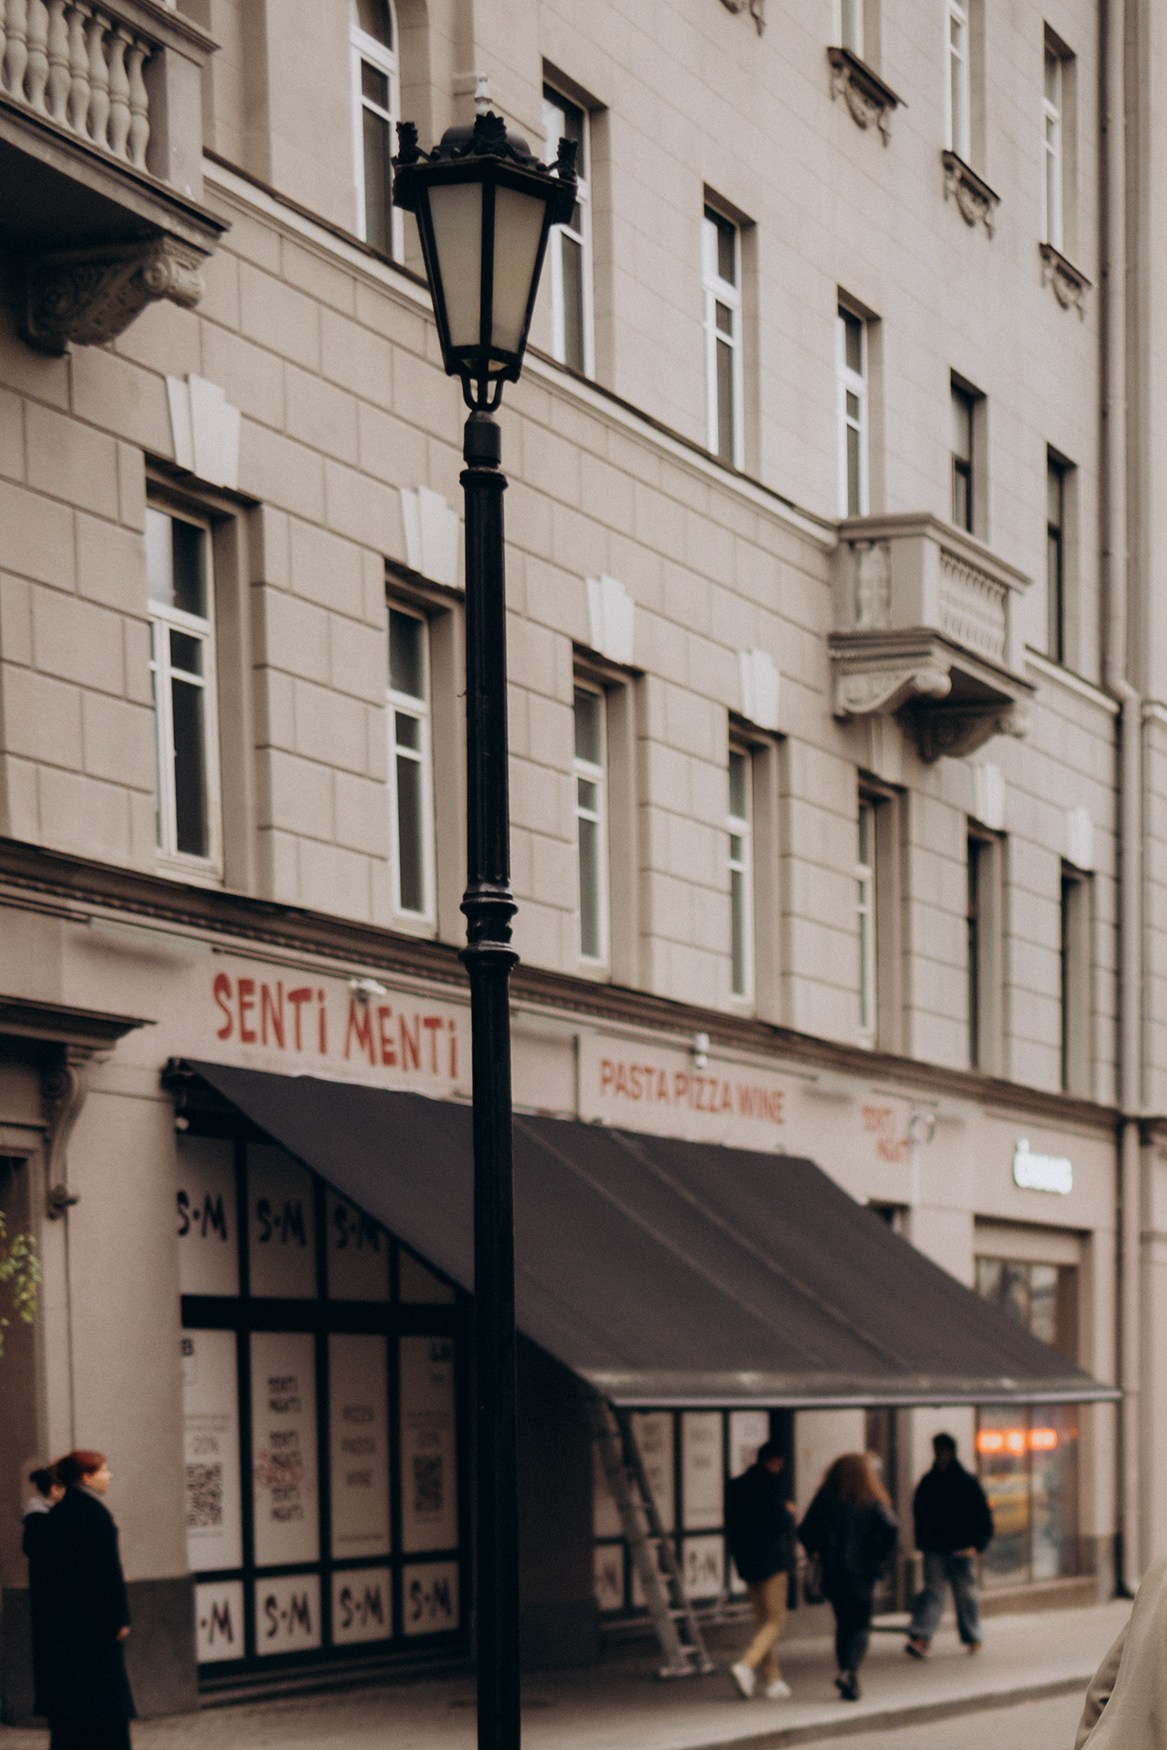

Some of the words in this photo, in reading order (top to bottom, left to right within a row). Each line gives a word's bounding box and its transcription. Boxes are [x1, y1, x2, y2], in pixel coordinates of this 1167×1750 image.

[600, 1058, 669, 1104] PASTA
[673, 1070, 734, 1115] PIZZA
[736, 1082, 785, 1126] WINE
